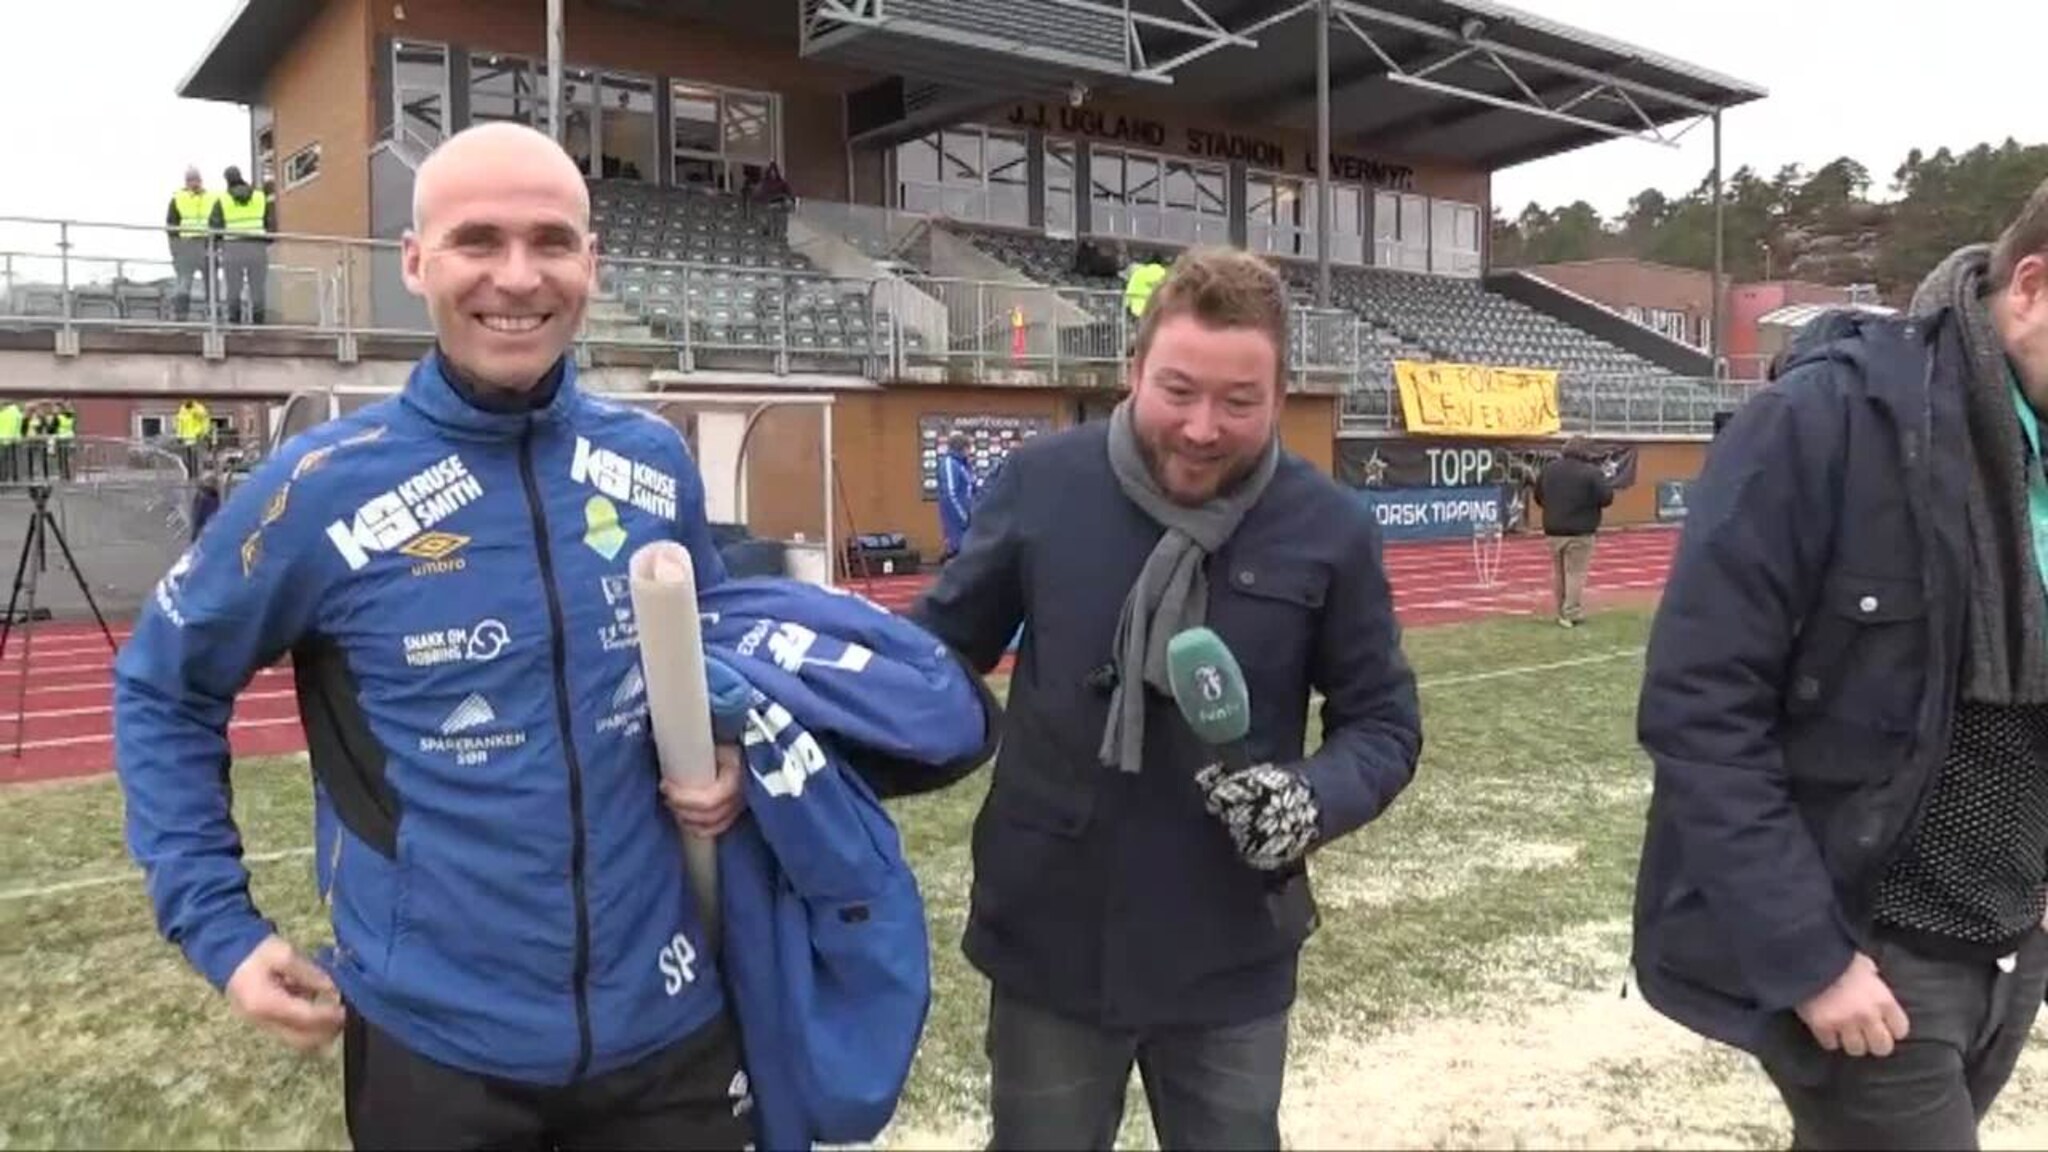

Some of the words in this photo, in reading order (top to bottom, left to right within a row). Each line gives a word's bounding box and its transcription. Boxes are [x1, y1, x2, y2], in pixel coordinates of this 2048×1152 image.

[1060, 106, 1165, 146] UGLAND
[1187, 128, 1283, 168] STADION
[398, 453, 468, 507] KRUSE
[414, 473, 484, 529] SMITH
[630, 483, 677, 522] SMITH
[632, 460, 677, 500] KRUSE
[1373, 502, 1428, 526] ORSK
[1431, 499, 1498, 524] TIPPING
[411, 557, 467, 577] umbro
[658, 932, 697, 997] SP
